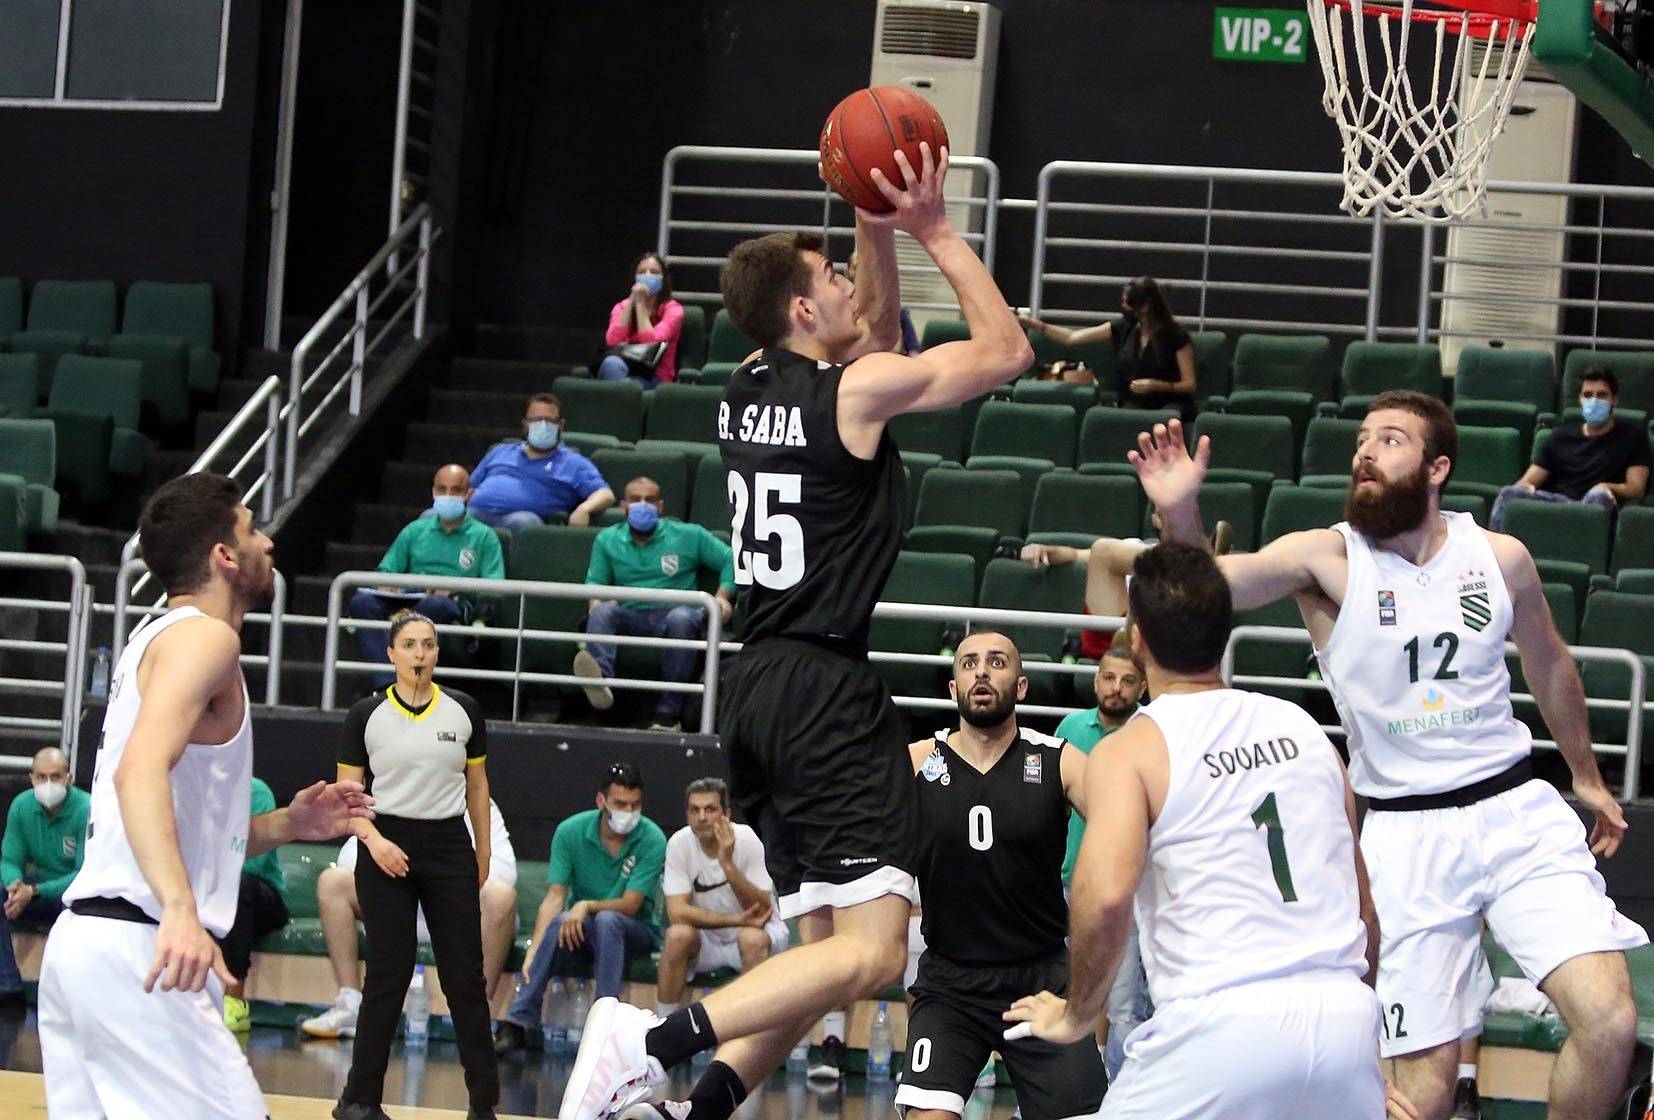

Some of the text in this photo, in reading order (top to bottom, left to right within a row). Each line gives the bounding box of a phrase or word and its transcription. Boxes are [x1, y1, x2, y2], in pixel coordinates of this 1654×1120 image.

[1221, 16, 1302, 55] VIP-2
[739, 404, 807, 447] SABA
[727, 470, 805, 591] 25
[1403, 631, 1460, 684] 12
[1203, 737, 1300, 779] SOUAID
[968, 804, 994, 851] 0
[1251, 791, 1299, 903] 1
[911, 1037, 932, 1073] 0
